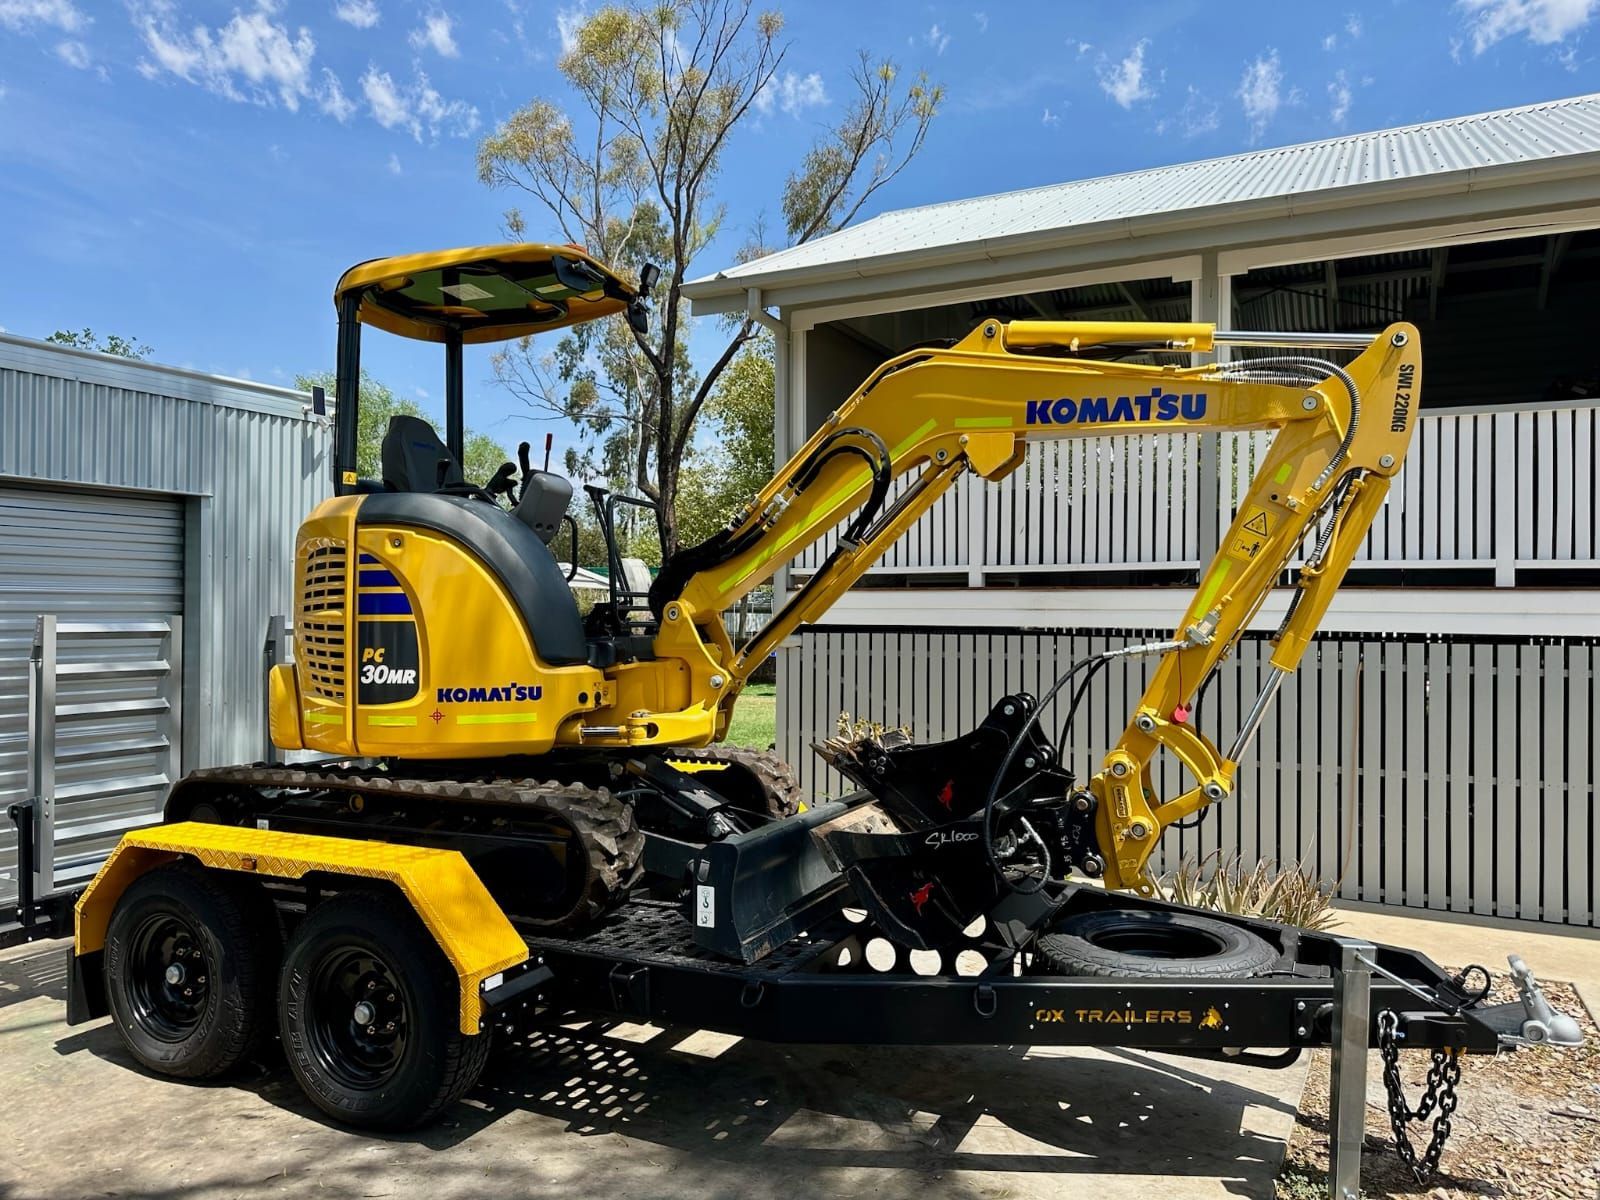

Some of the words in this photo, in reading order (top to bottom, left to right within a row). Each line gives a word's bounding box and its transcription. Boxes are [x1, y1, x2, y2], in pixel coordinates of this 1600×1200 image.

[1396, 363, 1415, 391] SWL
[1025, 387, 1208, 425] KOMATSU
[1390, 393, 1411, 433] 220KG
[361, 647, 386, 663] PC
[360, 664, 417, 685] 30MR
[437, 682, 543, 703] KOMATSU
[1035, 1009, 1066, 1023] OX
[1074, 1009, 1193, 1024] TRAILERS
